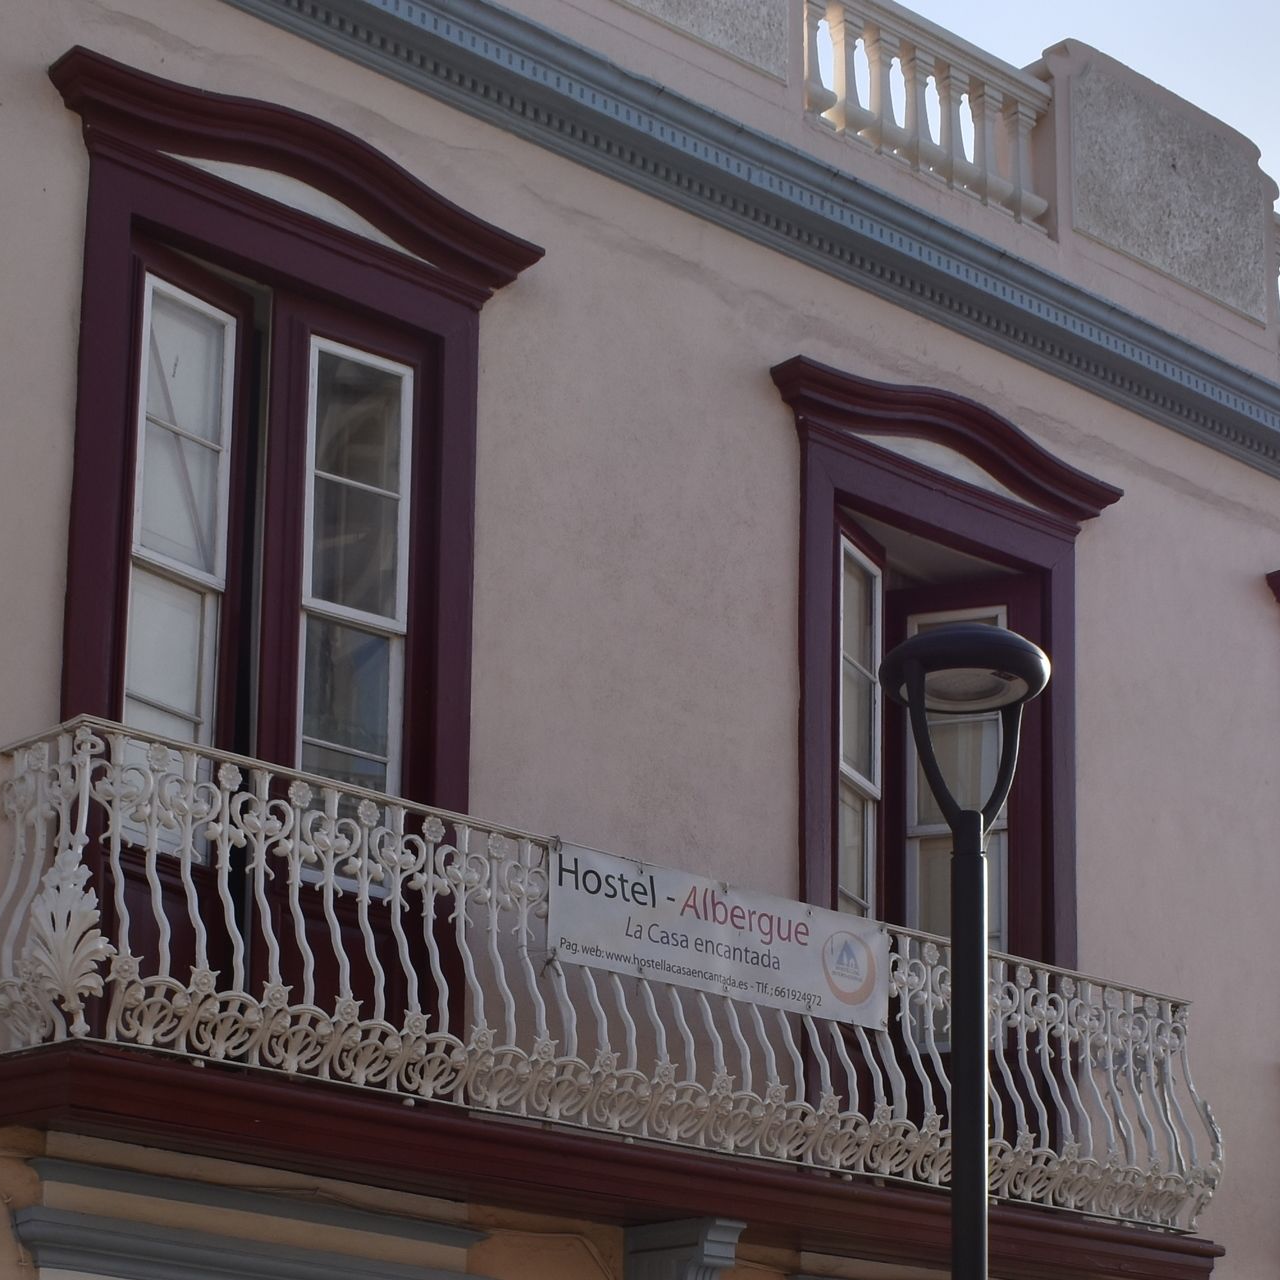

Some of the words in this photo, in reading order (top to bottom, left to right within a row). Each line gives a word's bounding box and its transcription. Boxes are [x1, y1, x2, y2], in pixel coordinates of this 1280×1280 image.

[557, 853, 657, 908] Hostel
[679, 885, 810, 946] Albergue
[560, 937, 580, 954] Pag.
[625, 916, 643, 940] La
[648, 923, 689, 949] Casa
[694, 936, 781, 971] encantada
